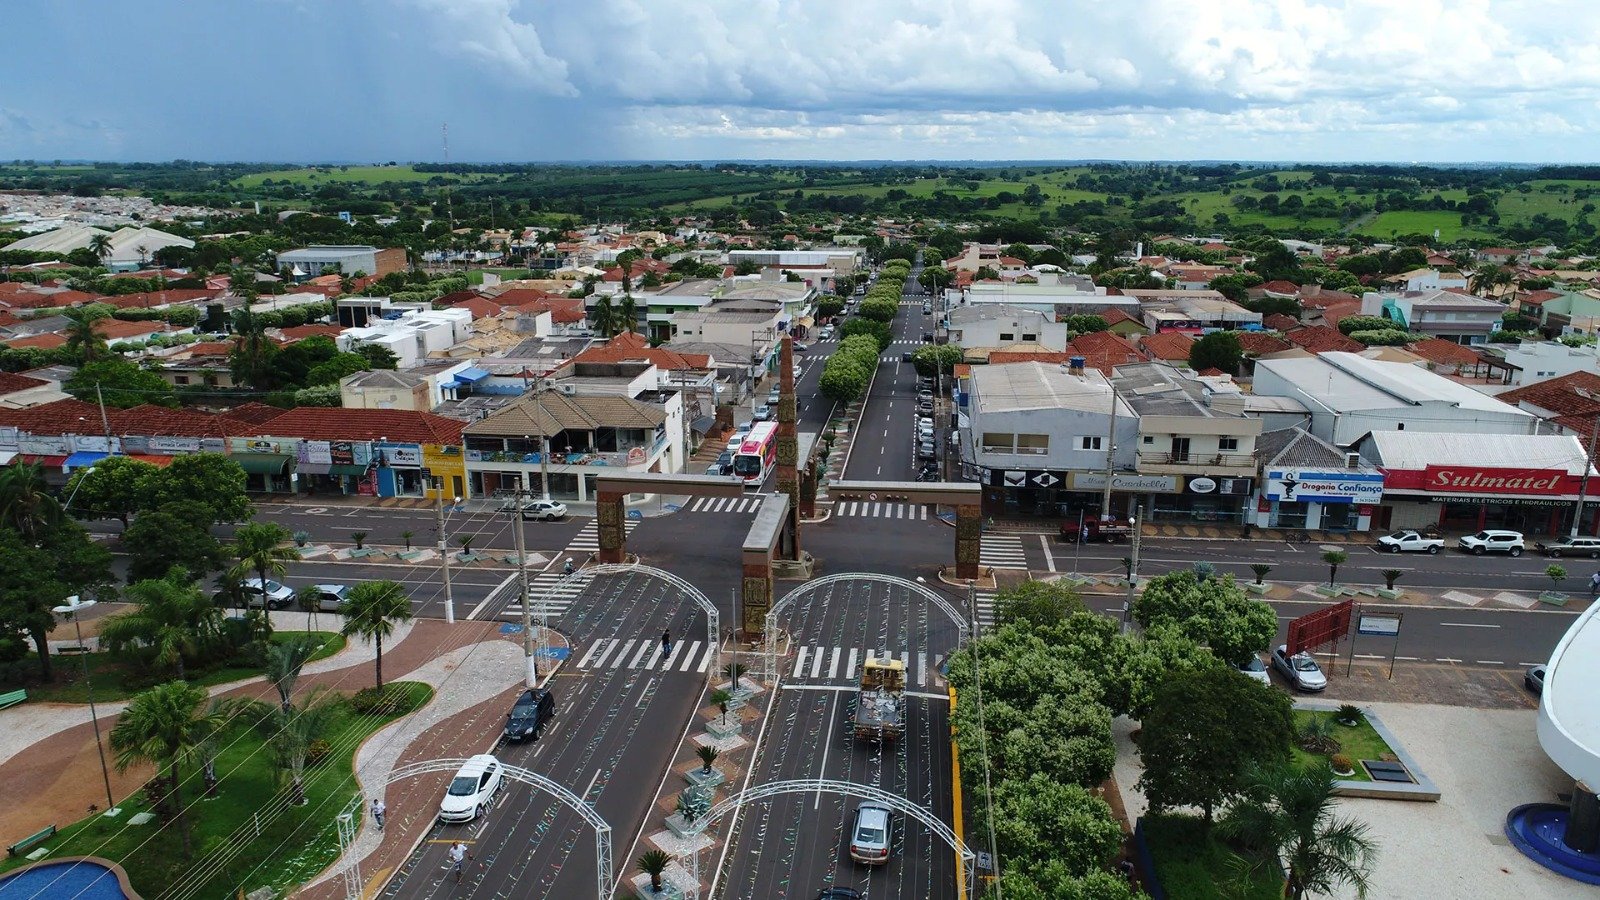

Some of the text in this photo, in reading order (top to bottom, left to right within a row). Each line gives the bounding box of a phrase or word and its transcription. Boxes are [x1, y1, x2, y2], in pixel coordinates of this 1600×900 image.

[1431, 470, 1561, 490] Sulmatel
[1302, 482, 1382, 493] Drogaria Confiança
[1432, 496, 1471, 504] MATERIAIS
[1472, 497, 1513, 505] ELÉTRICOS
